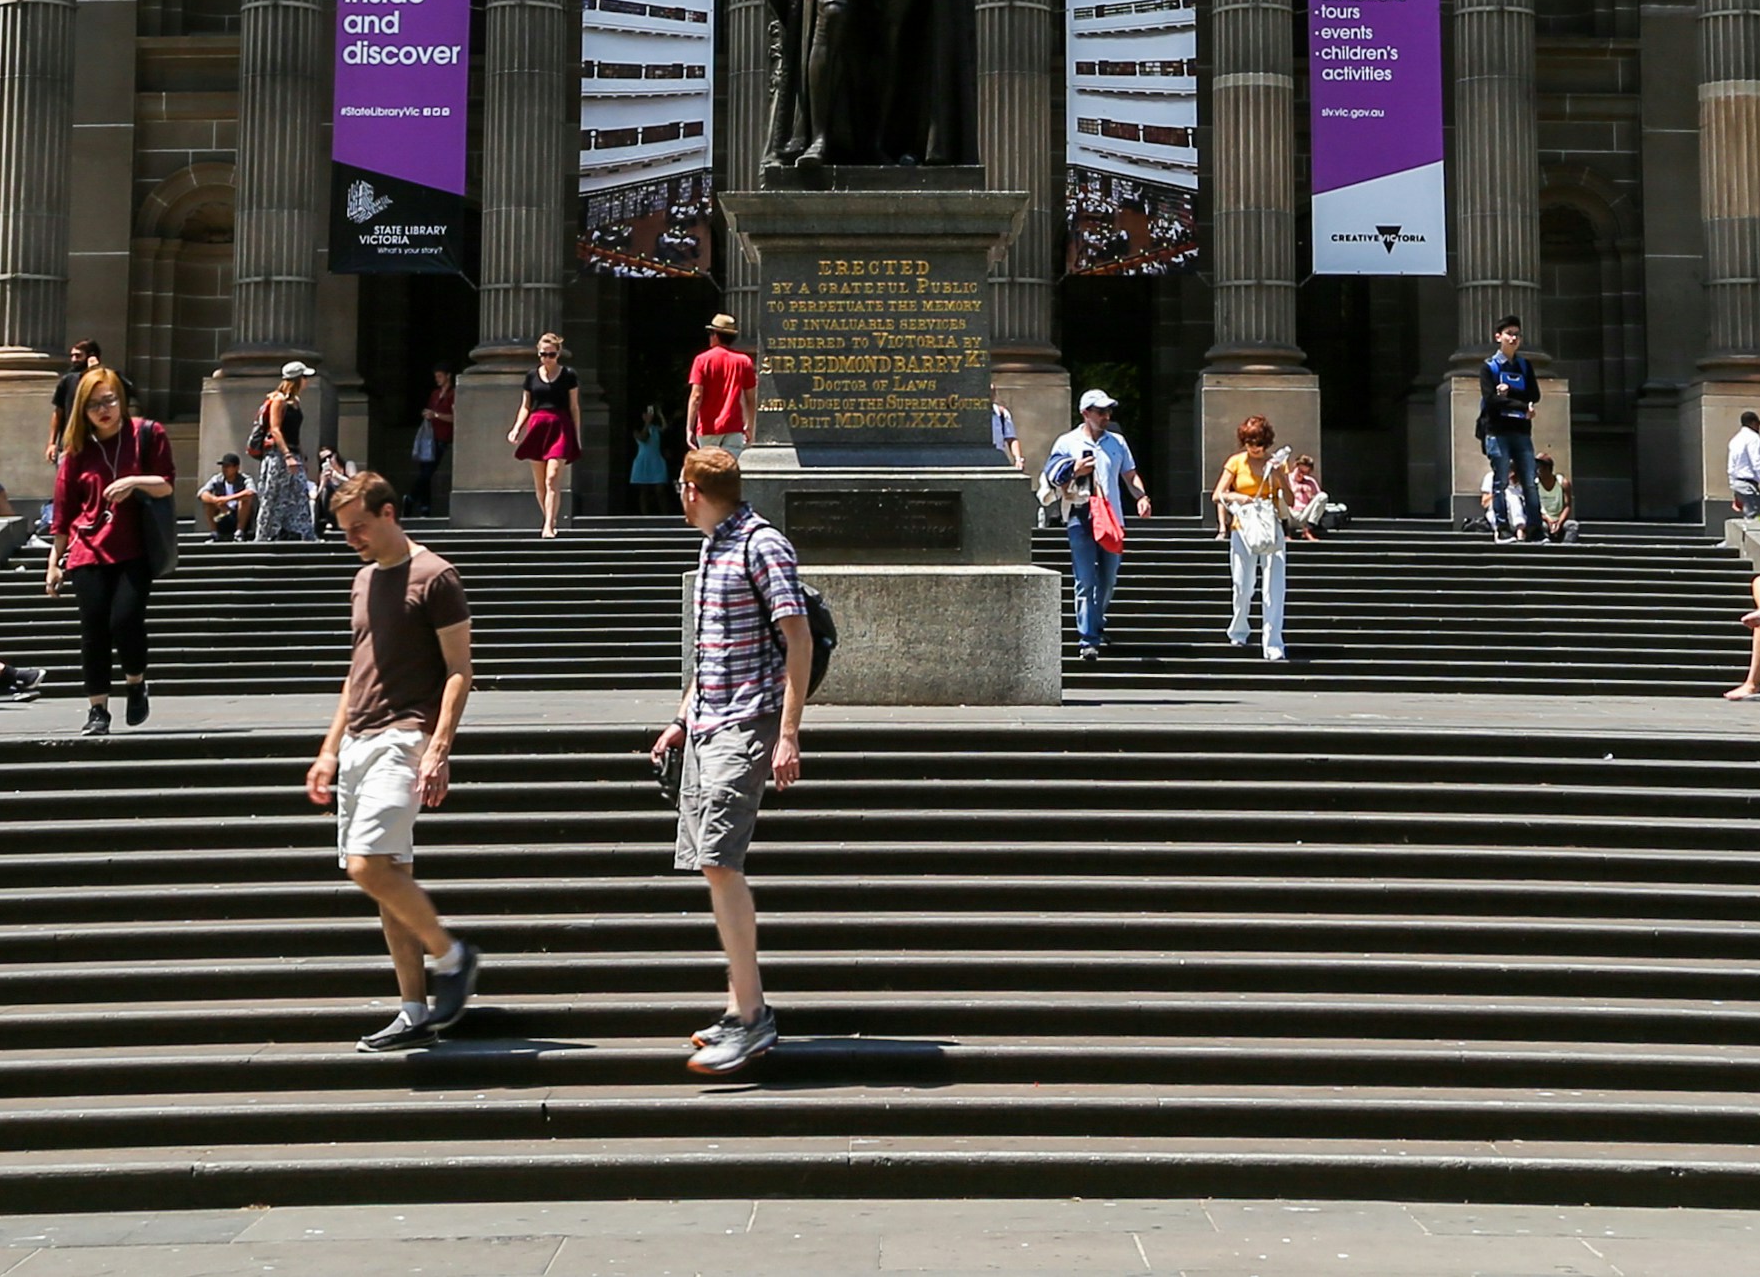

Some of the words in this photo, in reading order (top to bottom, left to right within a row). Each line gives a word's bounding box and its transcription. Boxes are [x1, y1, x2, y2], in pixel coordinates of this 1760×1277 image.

[1320, 4, 1361, 19] tours
[343, 10, 400, 34] and
[1321, 25, 1373, 40] events
[342, 40, 461, 65] discover
[1321, 45, 1398, 60] children's
[1322, 66, 1393, 81] activities
[340, 106, 420, 118] #StateLibraryVic
[1321, 107, 1385, 119] slv.vic.gov.au
[373, 225, 402, 235] STATE
[404, 225, 447, 235] LIBRARY
[358, 235, 410, 245] VICTORIA
[1331, 234, 1379, 242] CREATIVE
[1379, 234, 1426, 242] VICTORIA
[377, 246, 402, 254] What's
[421, 246, 443, 255] story?
[817, 260, 930, 276] ERECTED
[771, 282, 794, 295] BY
[798, 282, 811, 295] A
[818, 282, 909, 295] GRATEFUL
[766, 301, 785, 313] TO
[788, 300, 884, 313] PERPETUATE
[887, 300, 918, 312] THE
[921, 300, 982, 312] MEMORY
[782, 319, 799, 331] OF
[803, 319, 895, 331] INVALUABLE
[899, 318, 967, 331] SERVICES
[767, 337, 846, 349] RENDERED
[851, 337, 869, 349] TO
[962, 337, 982, 348] BY
[759, 355, 797, 375] SIR
[799, 355, 891, 373] REDMOND
[893, 355, 963, 373] BARRY
[872, 380, 889, 391] OF
[758, 399, 786, 412] AND
[786, 399, 797, 410] A
[842, 399, 856, 410] OF
[858, 398, 884, 410] THE
